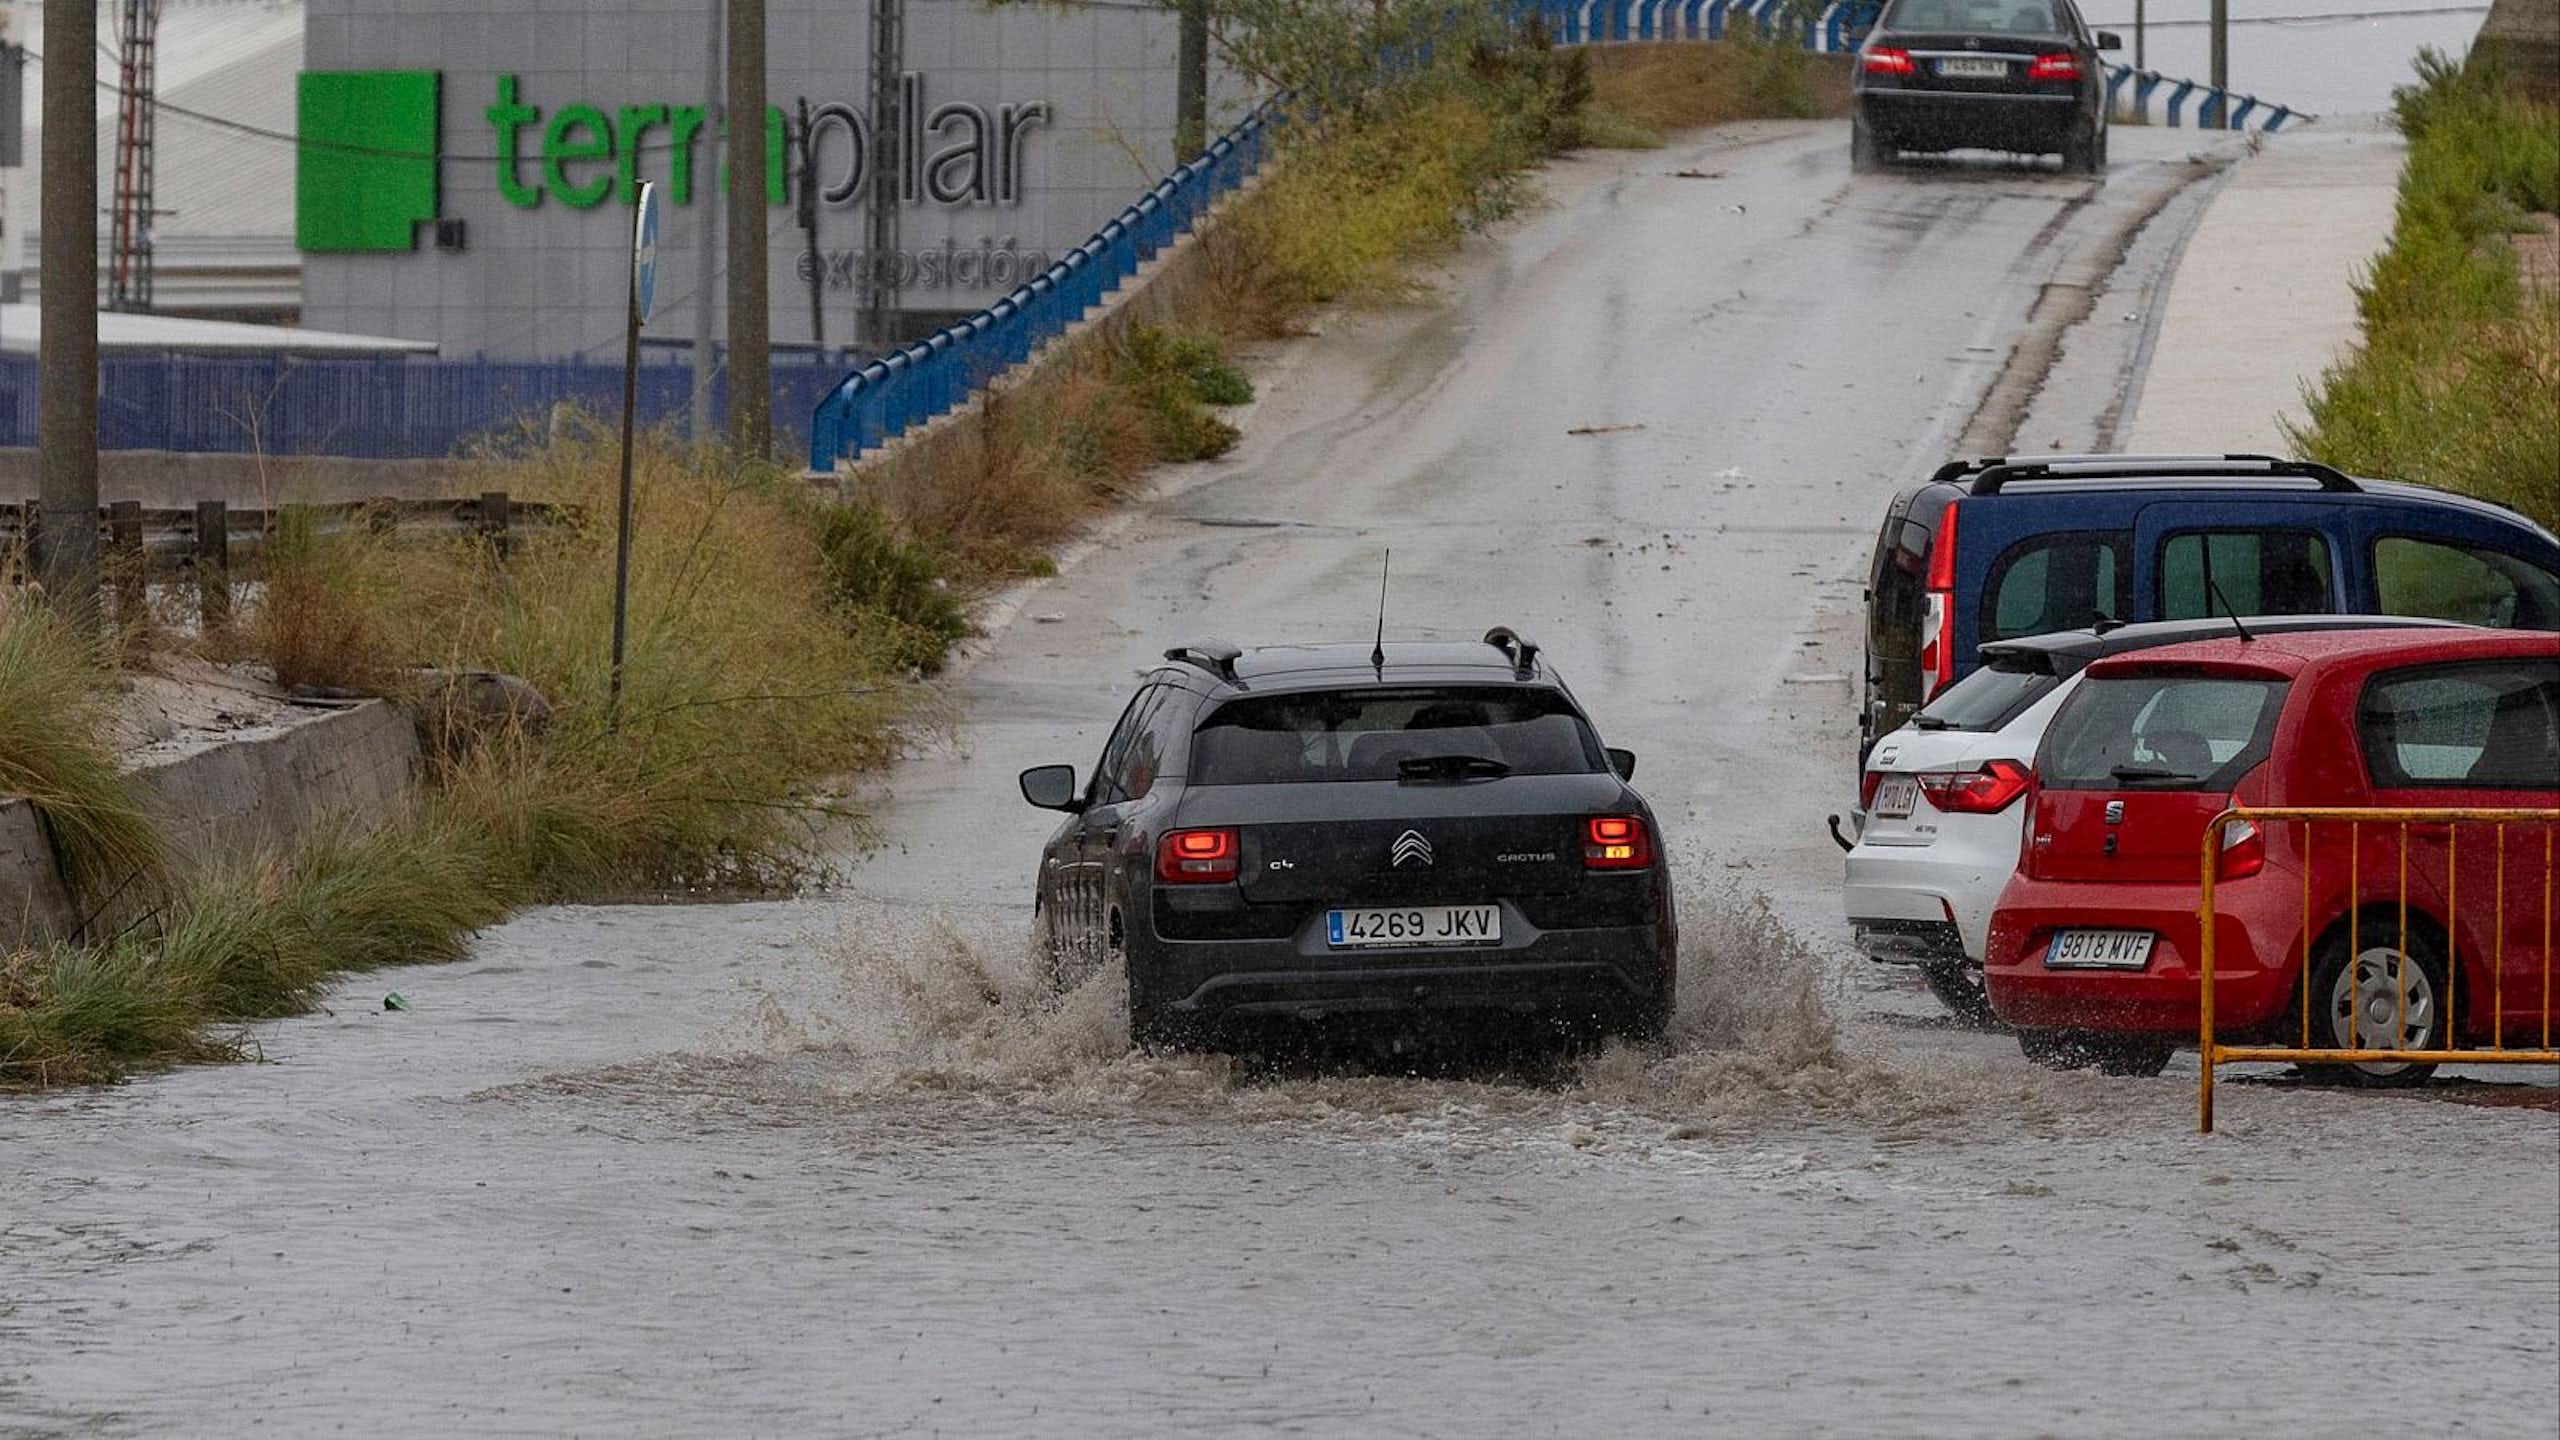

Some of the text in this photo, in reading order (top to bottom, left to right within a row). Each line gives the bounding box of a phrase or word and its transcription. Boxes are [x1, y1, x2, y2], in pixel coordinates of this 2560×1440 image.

[1349, 909, 1491, 939] 4269 JKV
[2060, 933, 2150, 960] 9818 MVF
